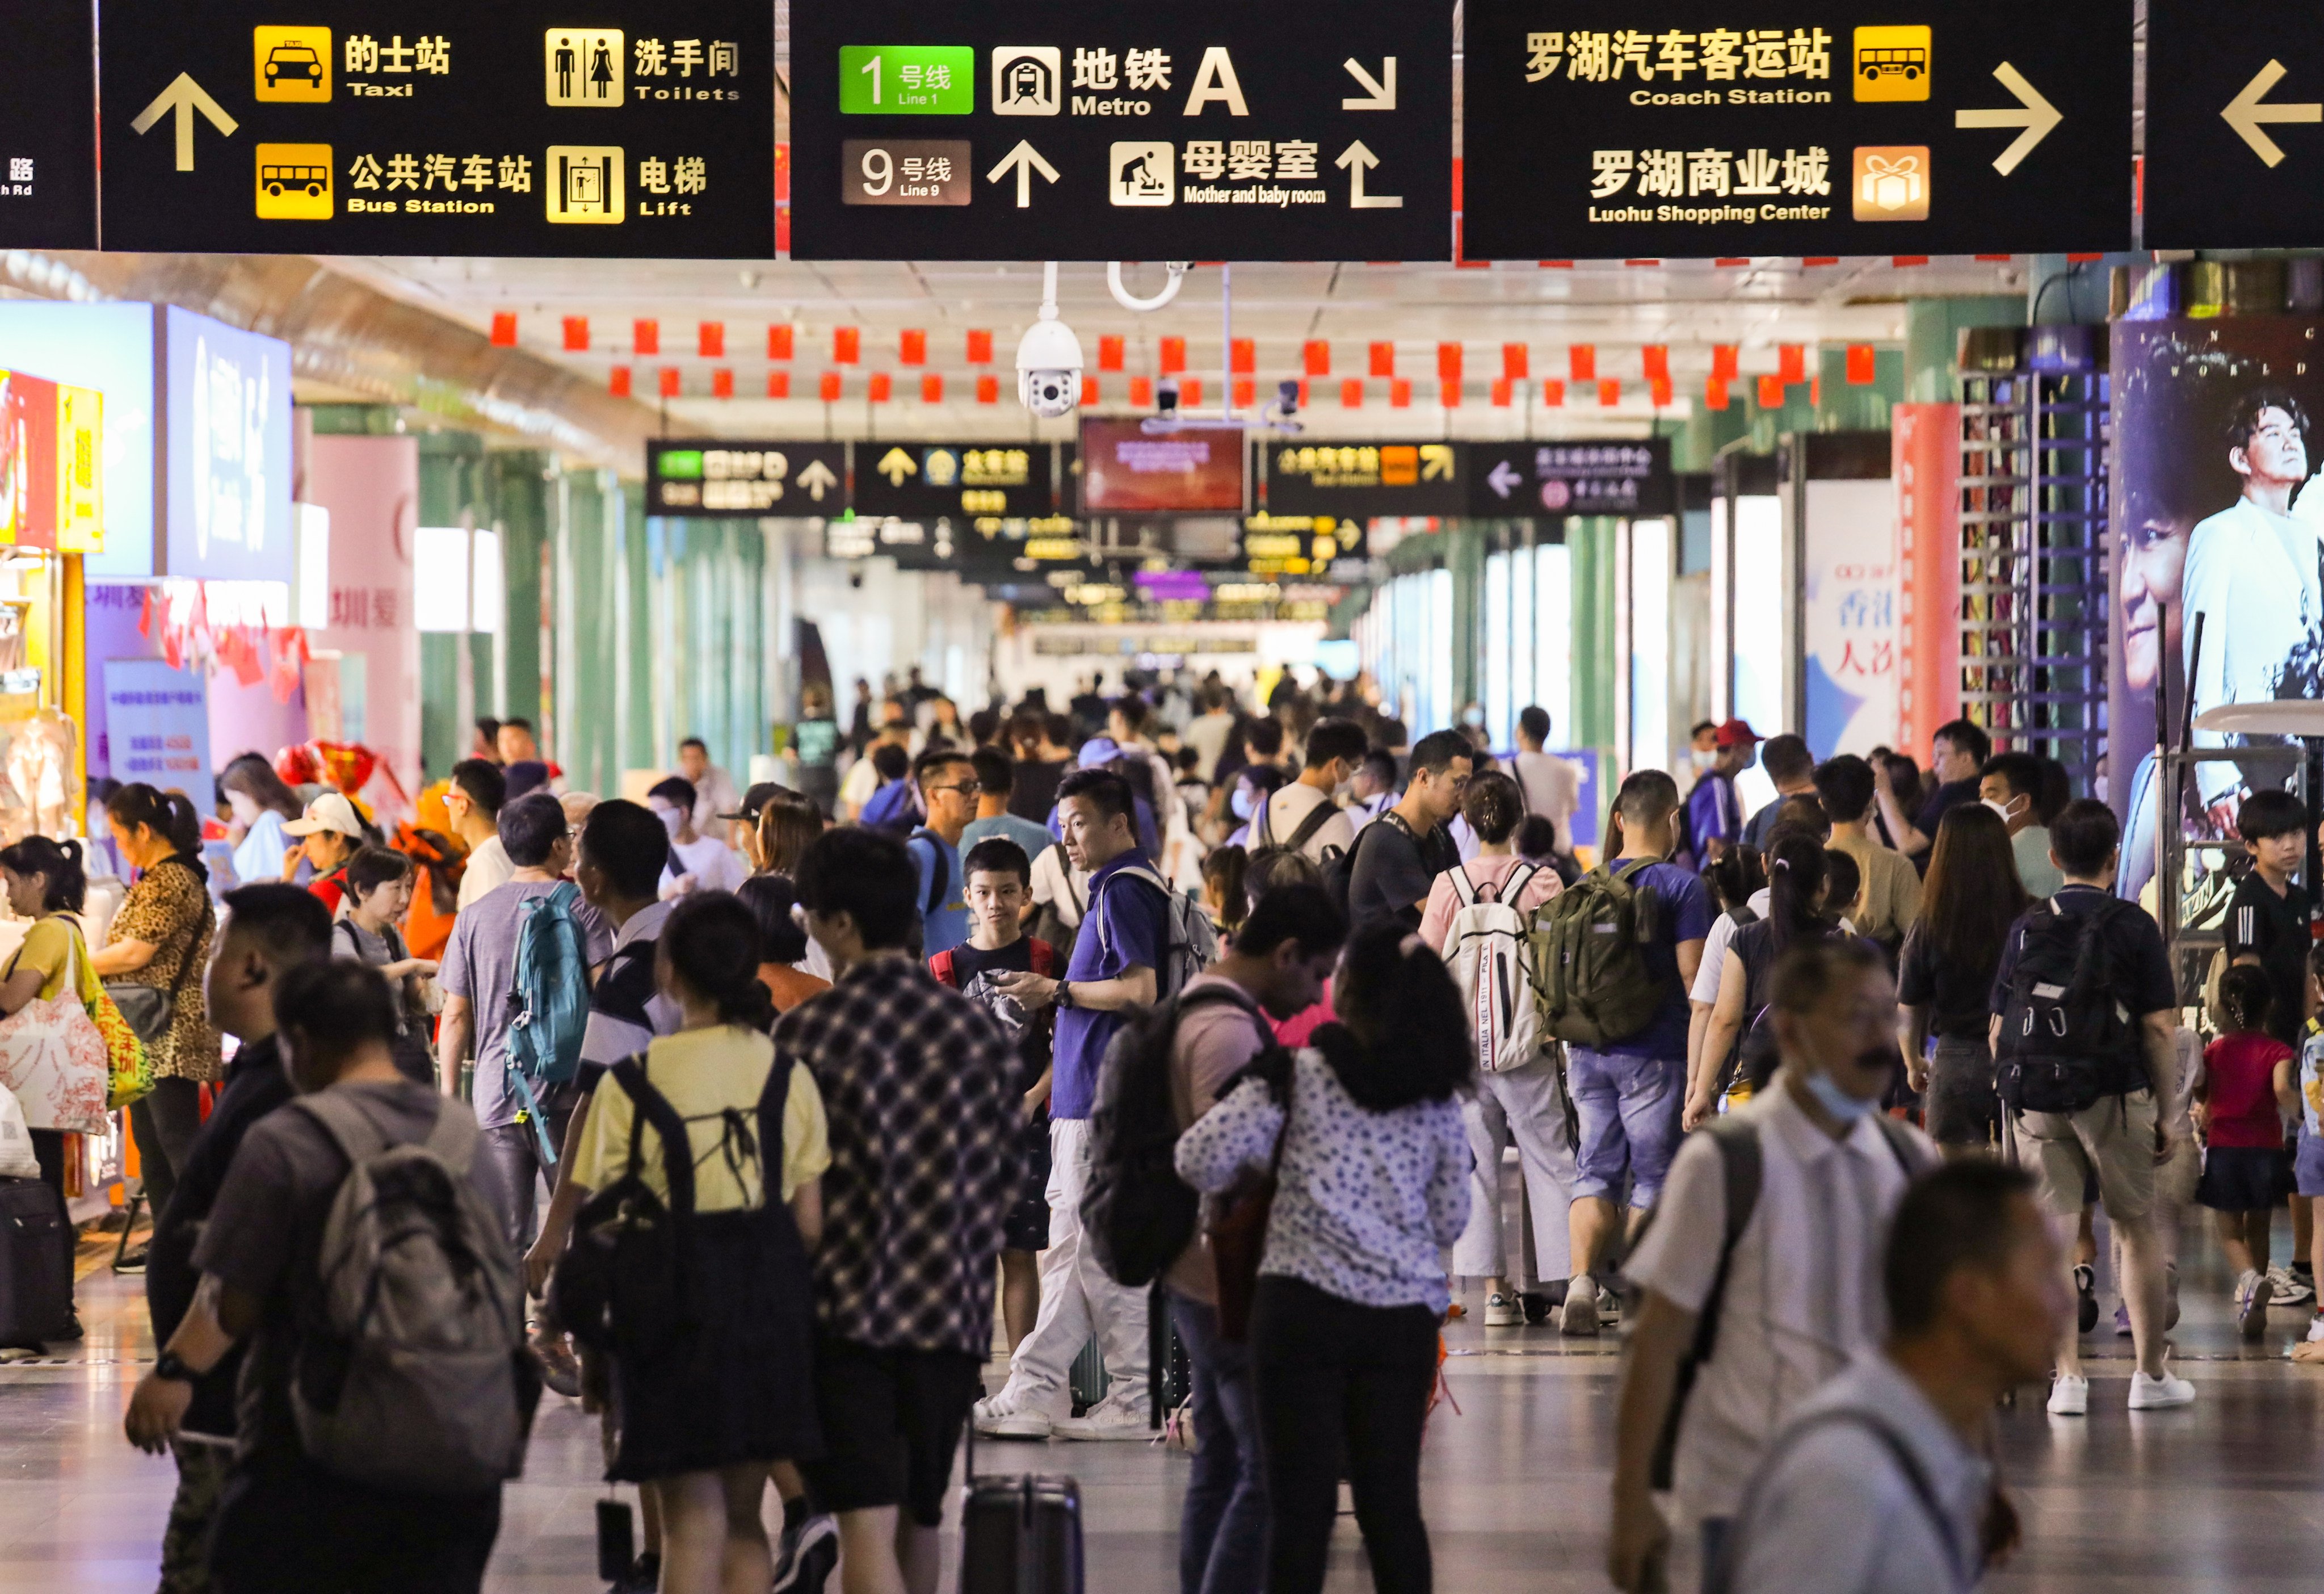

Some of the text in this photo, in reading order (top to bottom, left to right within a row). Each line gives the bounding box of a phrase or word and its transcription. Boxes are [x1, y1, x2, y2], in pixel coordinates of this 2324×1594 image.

[346, 35, 450, 74] 的士站
[634, 39, 737, 77] 洗手间
[1525, 28, 1831, 82] 罗湖汽车客运站
[347, 83, 412, 96] Taxi
[1072, 47, 1249, 115] 地铁 A
[634, 86, 738, 100] Toilets
[899, 94, 936, 104] Line 1
[1630, 89, 1831, 105] Coach Station
[1072, 96, 1150, 115] Metro
[10, 158, 33, 181] 路
[1182, 140, 1317, 179] 母婴室
[349, 154, 531, 192] 公共汽车站
[641, 157, 705, 194] 电梯
[1591, 146, 1830, 198] 罗湖商业城
[13, 185, 32, 195] Rd
[901, 184, 939, 196] Line 9
[1184, 185, 1326, 208] Mother and baby room
[348, 199, 494, 213] Bus Station
[641, 202, 691, 215] Lift
[1589, 204, 1830, 224] Luohu Shopping Center
